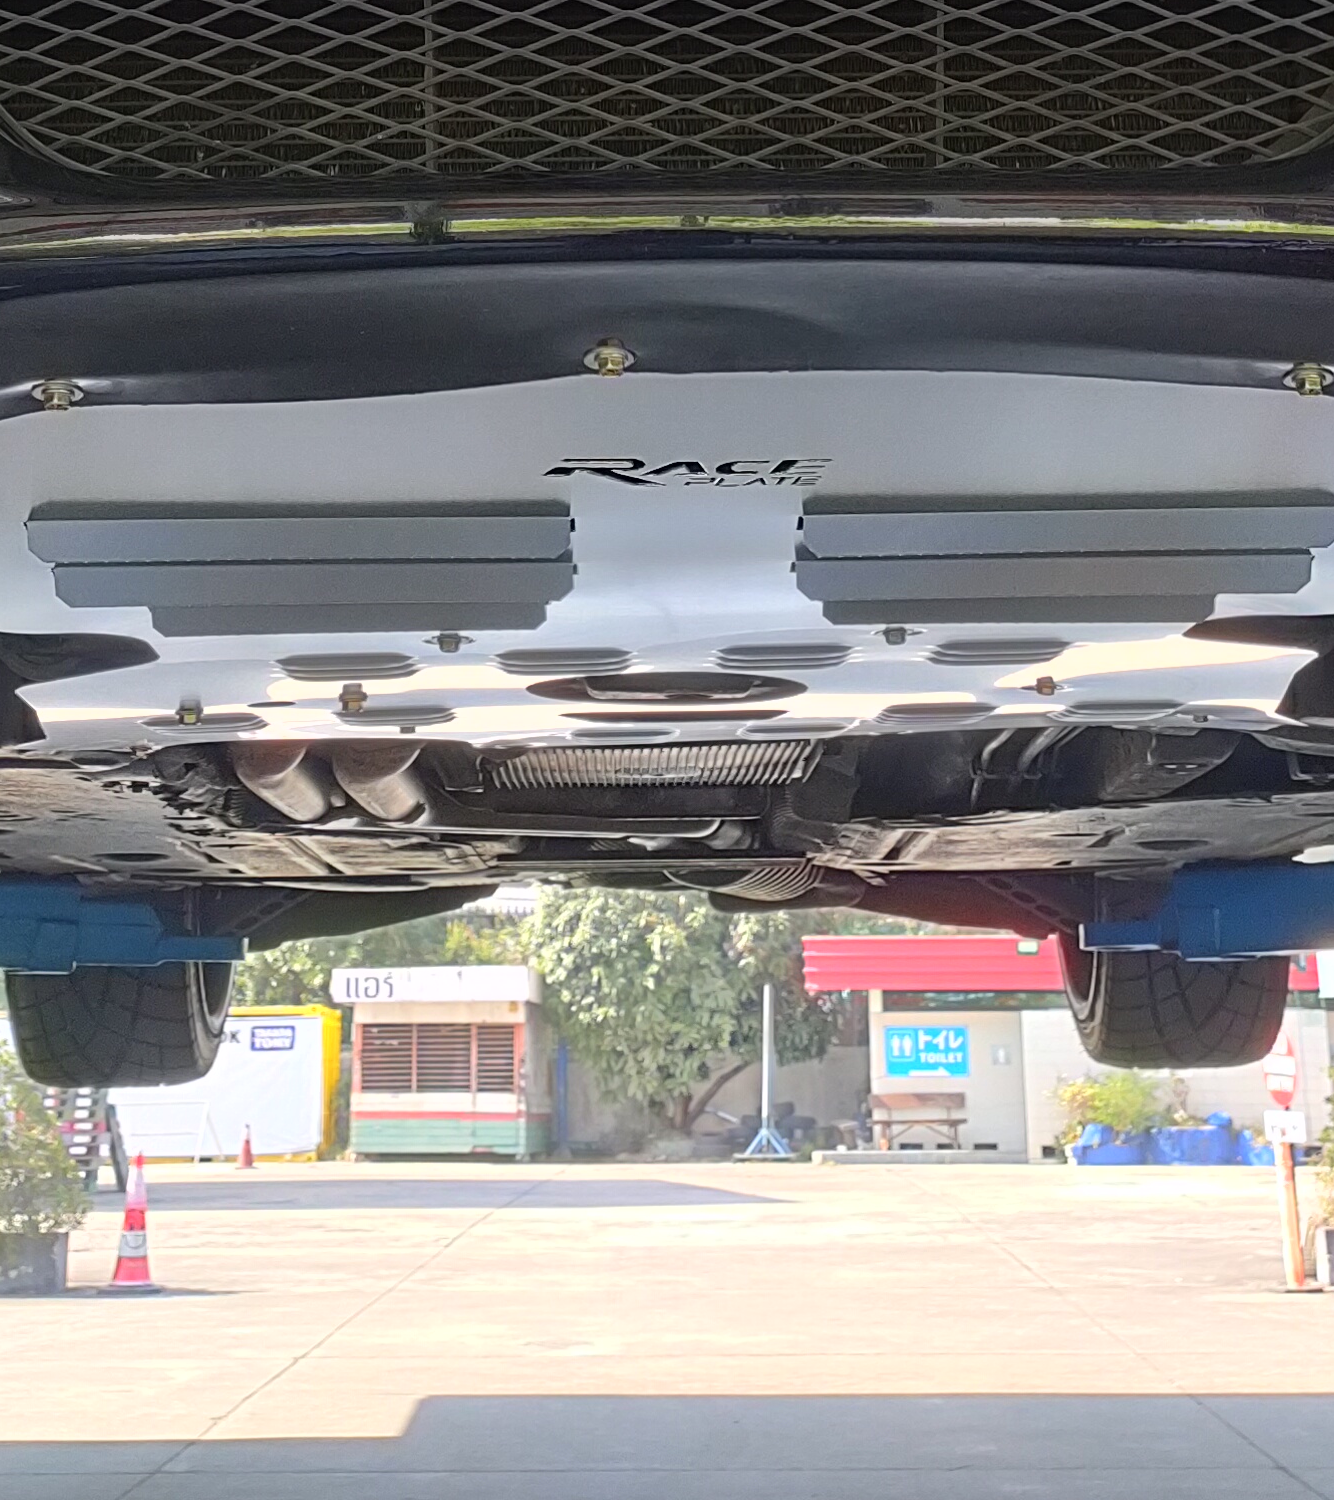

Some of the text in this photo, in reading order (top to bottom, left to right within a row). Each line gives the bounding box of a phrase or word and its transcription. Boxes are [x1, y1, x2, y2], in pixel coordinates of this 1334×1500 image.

[543, 458, 833, 486] RACE
[683, 475, 822, 487] PLATE
[918, 1029, 964, 1050] トイレ
[918, 1051, 964, 1063] TOILET
